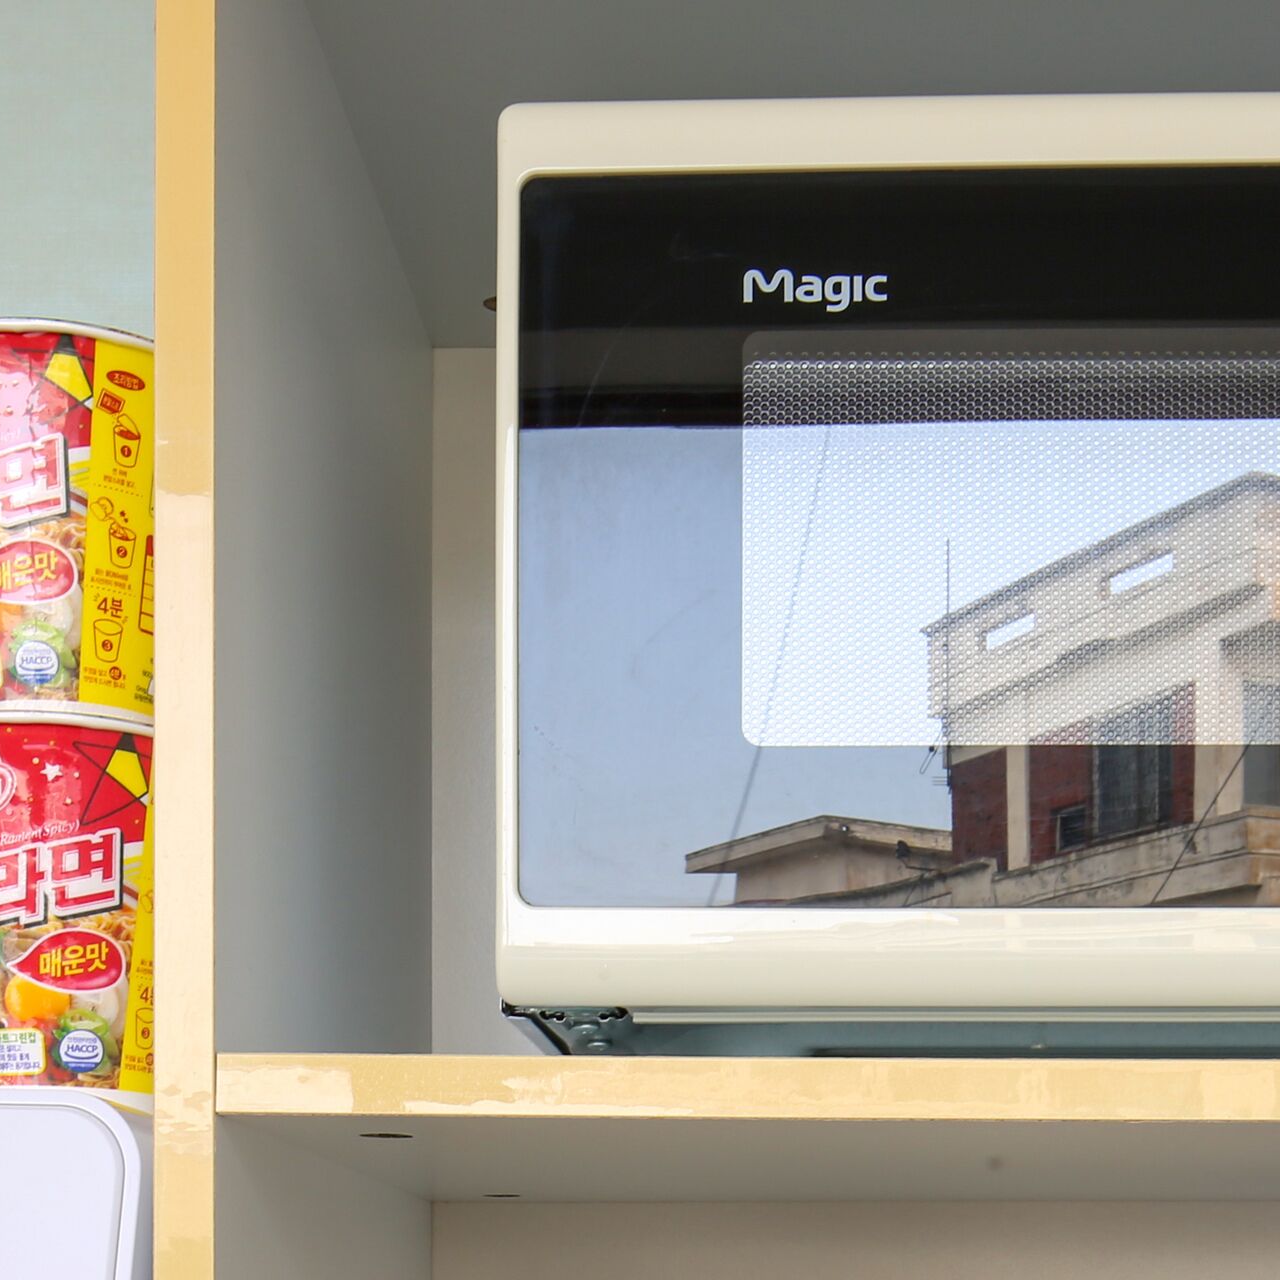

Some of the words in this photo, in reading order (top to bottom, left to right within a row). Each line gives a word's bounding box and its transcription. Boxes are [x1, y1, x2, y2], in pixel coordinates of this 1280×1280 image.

[742, 268, 889, 313] Magic
[96, 596, 124, 619] 4분
[37, 943, 110, 977] 매운맛
[66, 1044, 99, 1055] HACCP
